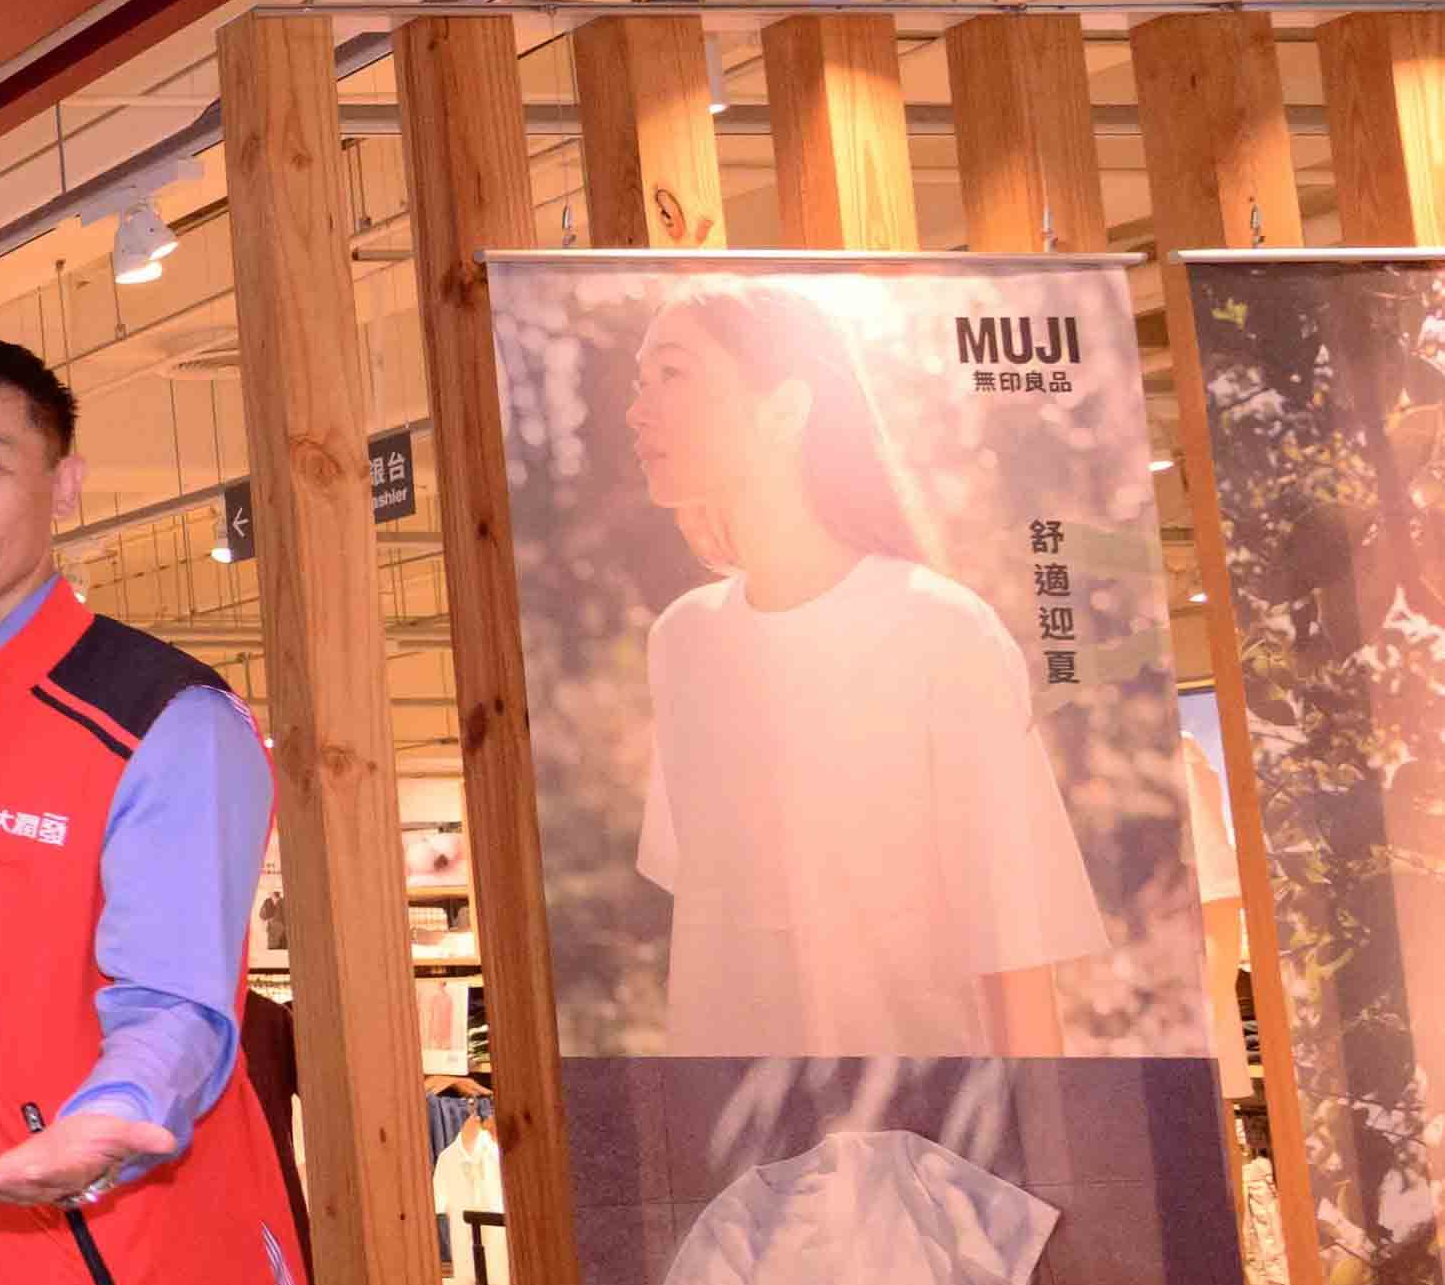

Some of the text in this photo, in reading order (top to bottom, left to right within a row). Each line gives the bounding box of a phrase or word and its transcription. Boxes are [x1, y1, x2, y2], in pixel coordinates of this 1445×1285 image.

[956, 316, 1083, 366] MUJI
[971, 369, 1074, 394] 無印良品
[1028, 519, 1081, 686] 舒適迎夏
